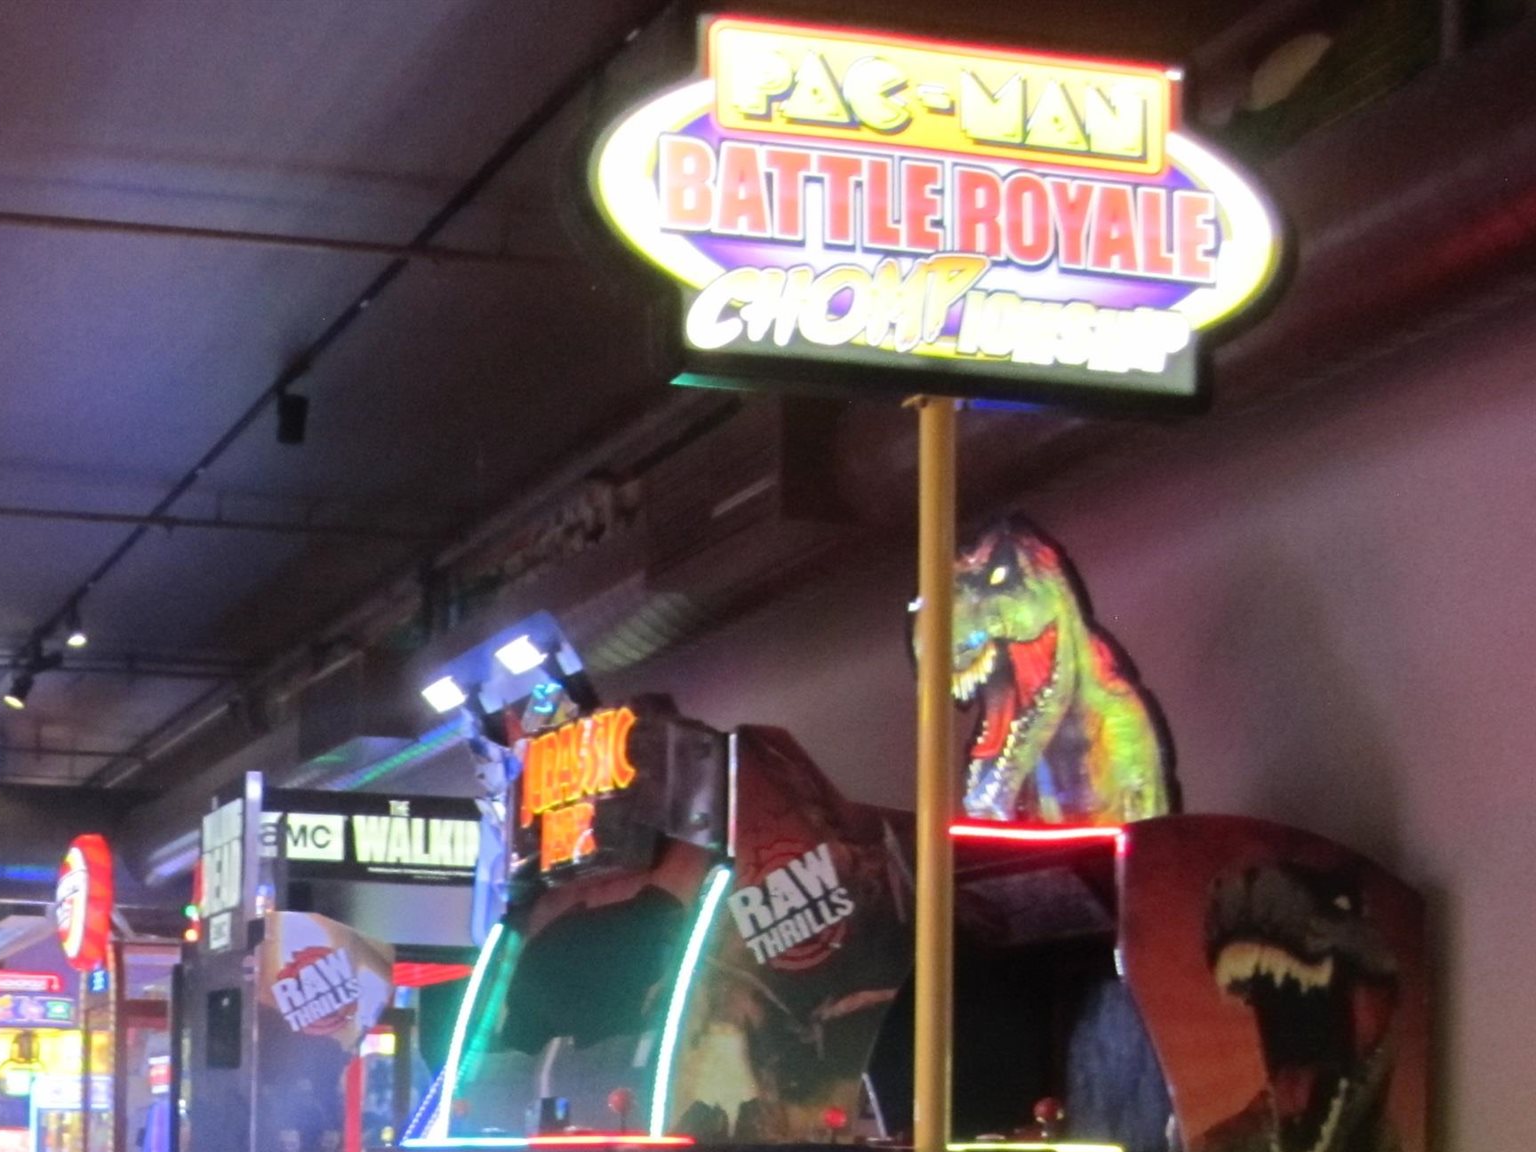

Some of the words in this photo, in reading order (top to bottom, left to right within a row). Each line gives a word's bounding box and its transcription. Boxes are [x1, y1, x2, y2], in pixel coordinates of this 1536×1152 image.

[726, 46, 1150, 160] PAC-MAN
[659, 134, 946, 252] BATTLE
[953, 165, 1216, 285] ROYALE
[728, 842, 839, 941] RAW
[746, 887, 855, 964] THRILLS
[271, 947, 354, 1015] RAW
[284, 978, 363, 1032] THRILLS
